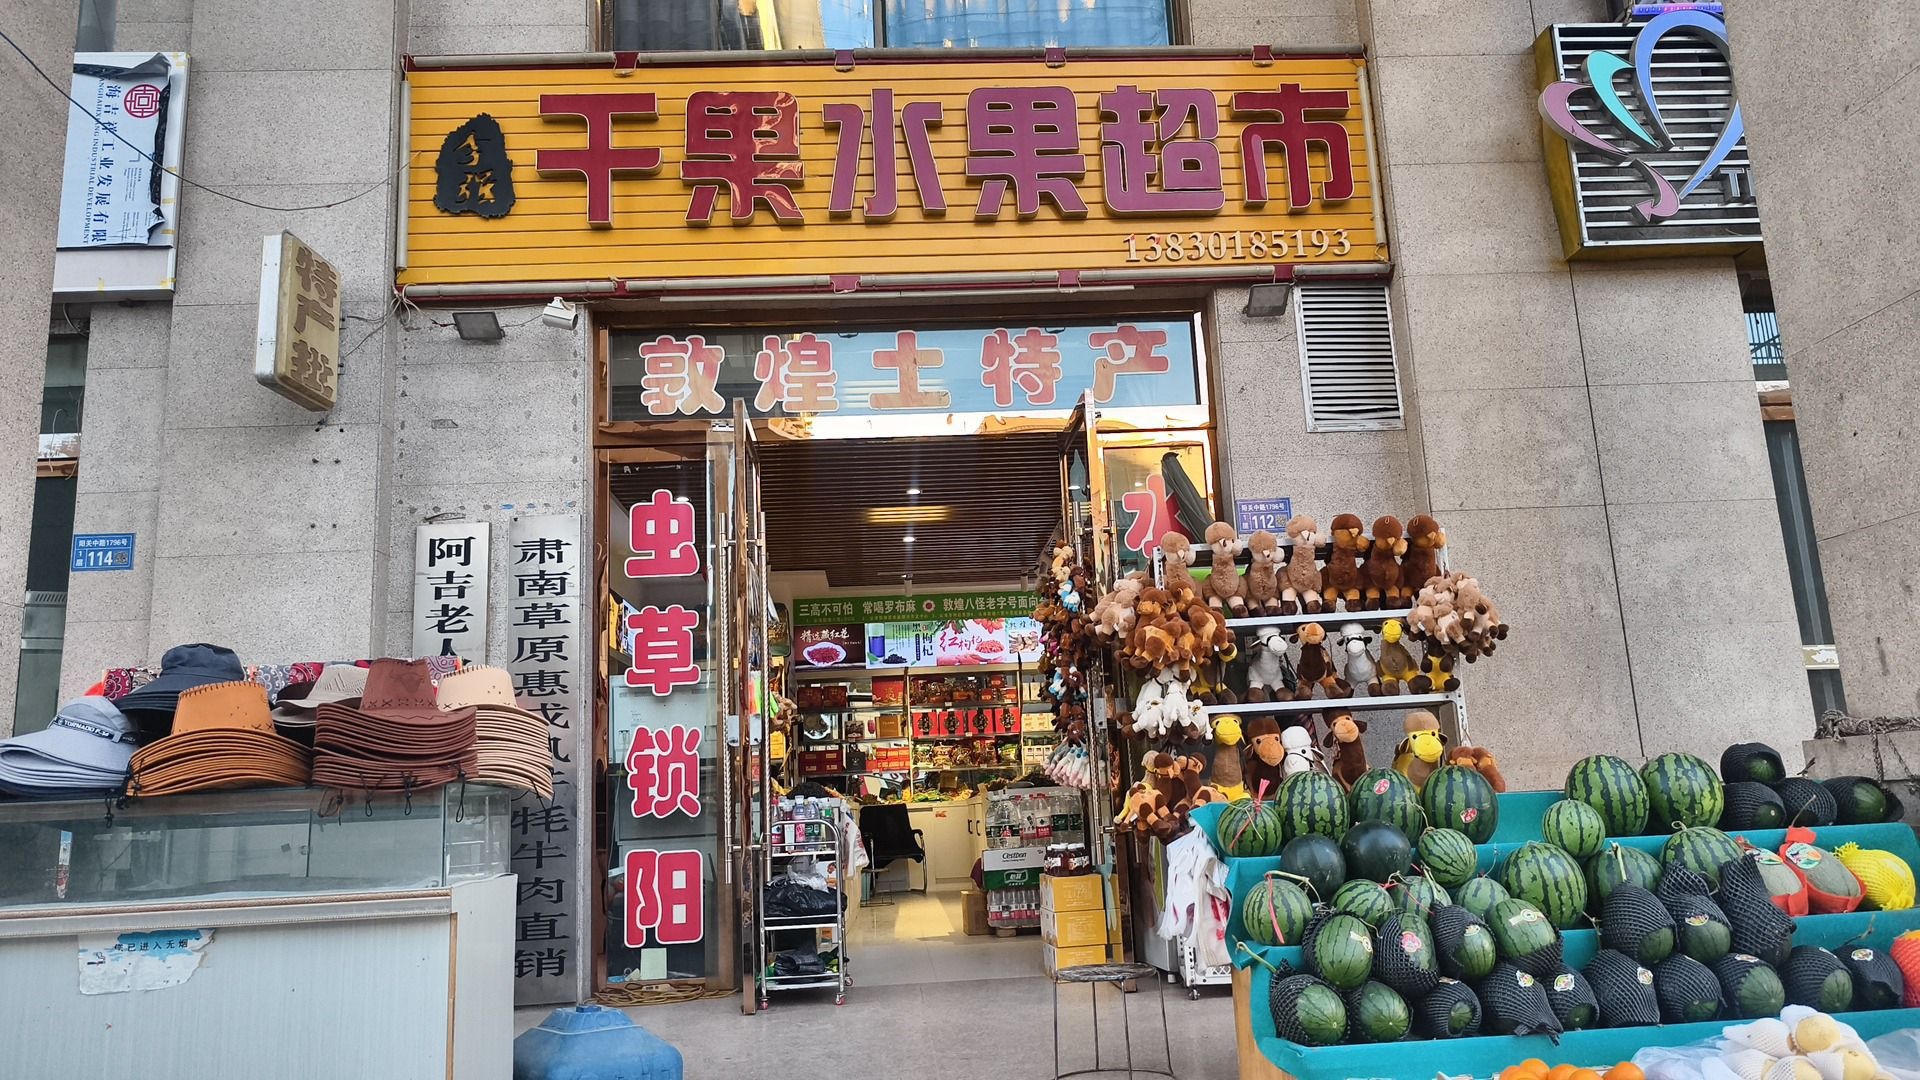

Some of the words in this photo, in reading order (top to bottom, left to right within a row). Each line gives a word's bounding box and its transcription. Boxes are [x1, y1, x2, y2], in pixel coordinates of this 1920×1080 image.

[89, 138, 99, 186] INDUSTRIAL
[91, 84, 122, 244] 海吉祥工业发展有限
[535, 84, 1356, 228] 干果水果超市
[82, 186, 94, 244] DEVELOPMENT
[1122, 229, 1352, 263] 13830185193
[639, 323, 1170, 416] 敦煌土特产
[1252, 514, 1275, 529] 112
[88, 550, 113, 566] 114
[799, 602, 854, 617] 三高不可怕
[862, 600, 917, 615] 常喝罗布麻
[943, 595, 1044, 612] 敦煌八怪老字号面向
[624, 489, 704, 949] 虫草锁阳
